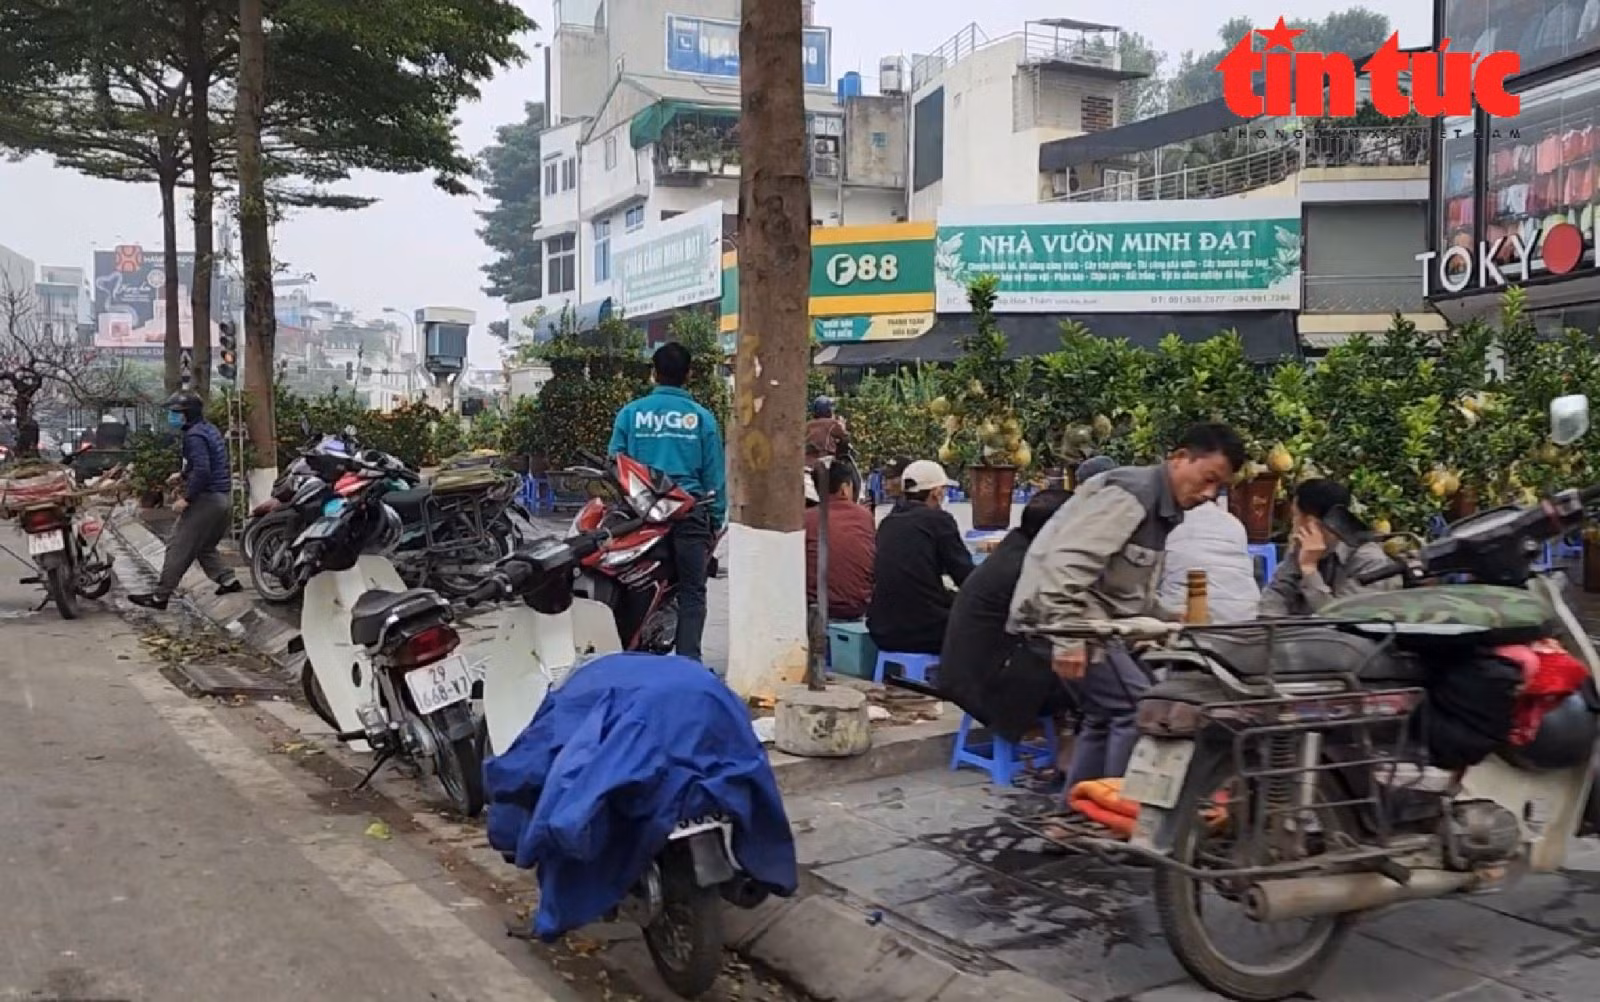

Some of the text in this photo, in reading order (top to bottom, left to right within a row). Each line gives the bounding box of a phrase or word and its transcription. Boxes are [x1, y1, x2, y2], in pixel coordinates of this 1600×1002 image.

[979, 228, 1257, 255] NHÀ VƯỜN MINH ĐẠT
[826, 253, 898, 285] F88
[428, 665, 446, 685] 29
